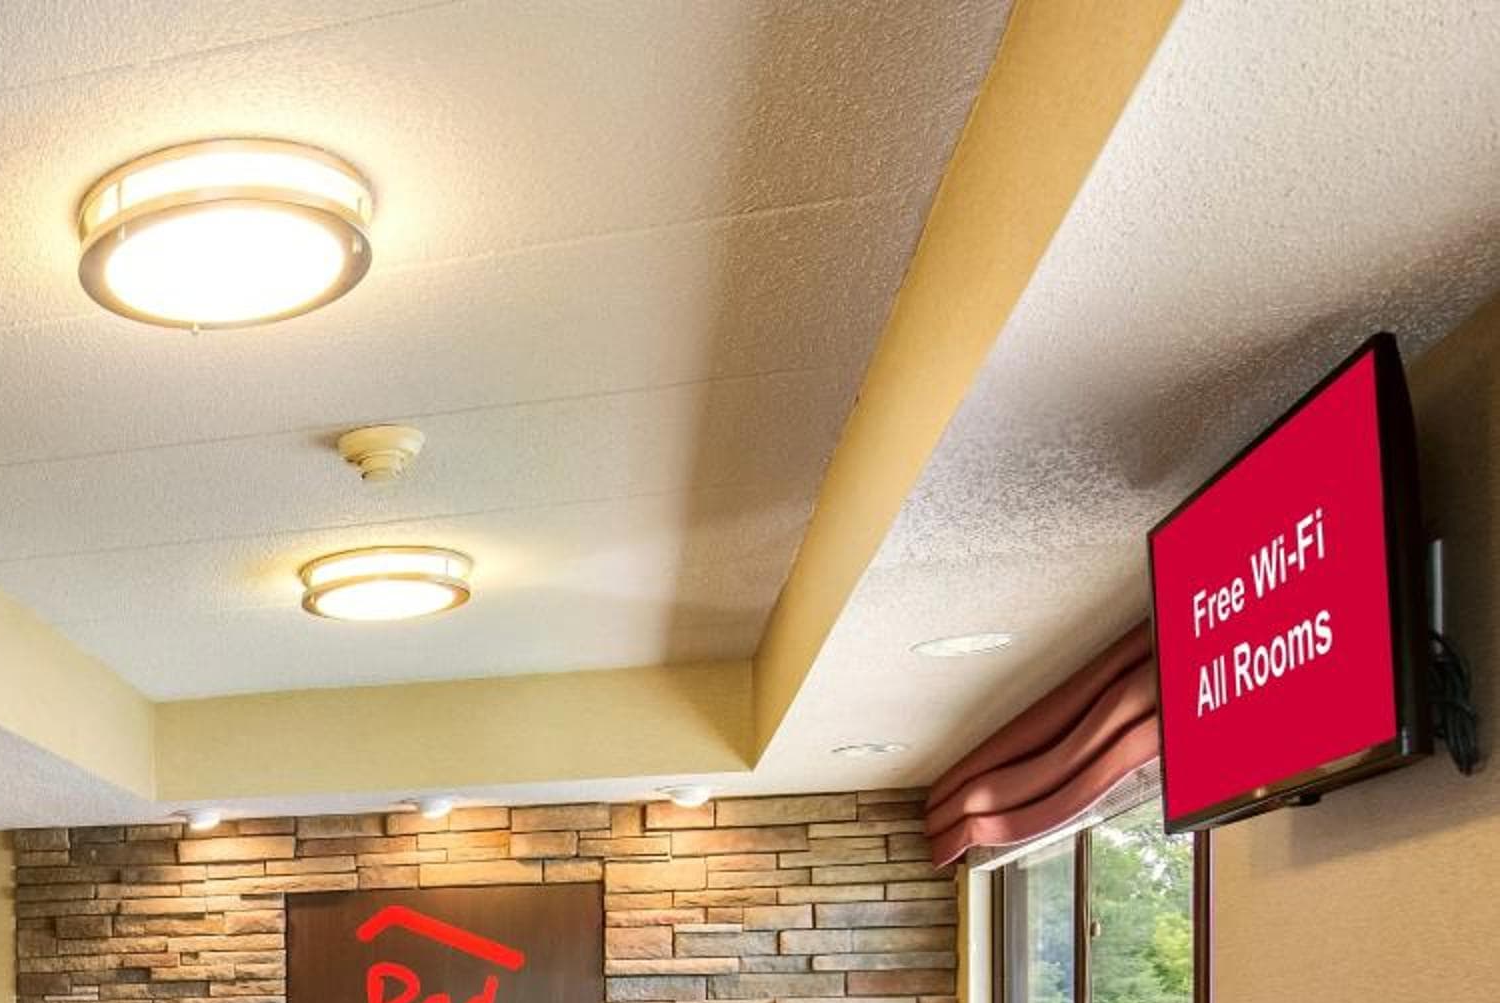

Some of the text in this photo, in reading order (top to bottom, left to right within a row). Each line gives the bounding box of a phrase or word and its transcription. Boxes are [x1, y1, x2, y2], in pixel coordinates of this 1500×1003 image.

[1193, 508, 1325, 638] Free Wi-Fi
[1197, 609, 1333, 717] All Rooms
